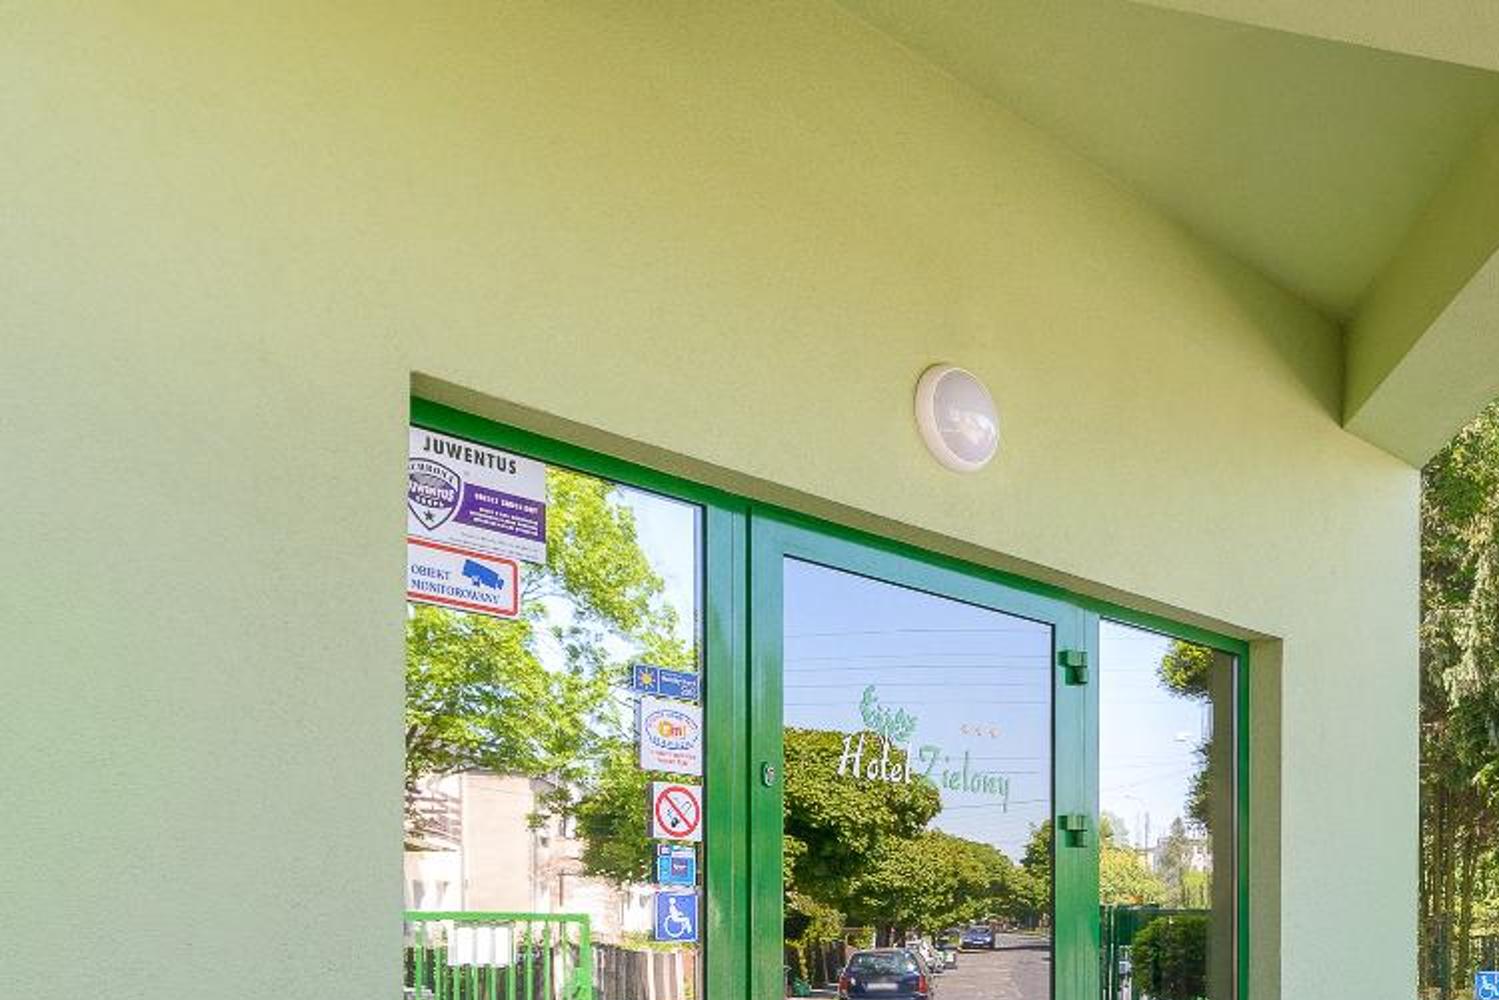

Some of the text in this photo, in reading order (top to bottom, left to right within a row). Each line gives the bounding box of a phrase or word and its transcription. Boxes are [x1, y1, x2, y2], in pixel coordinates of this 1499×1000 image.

[423, 436, 518, 475] JUWENTUS
[410, 564, 451, 581] OBIEKT
[410, 579, 501, 605] MONITOROWANY
[836, 733, 1010, 813] Hotel Zielony
